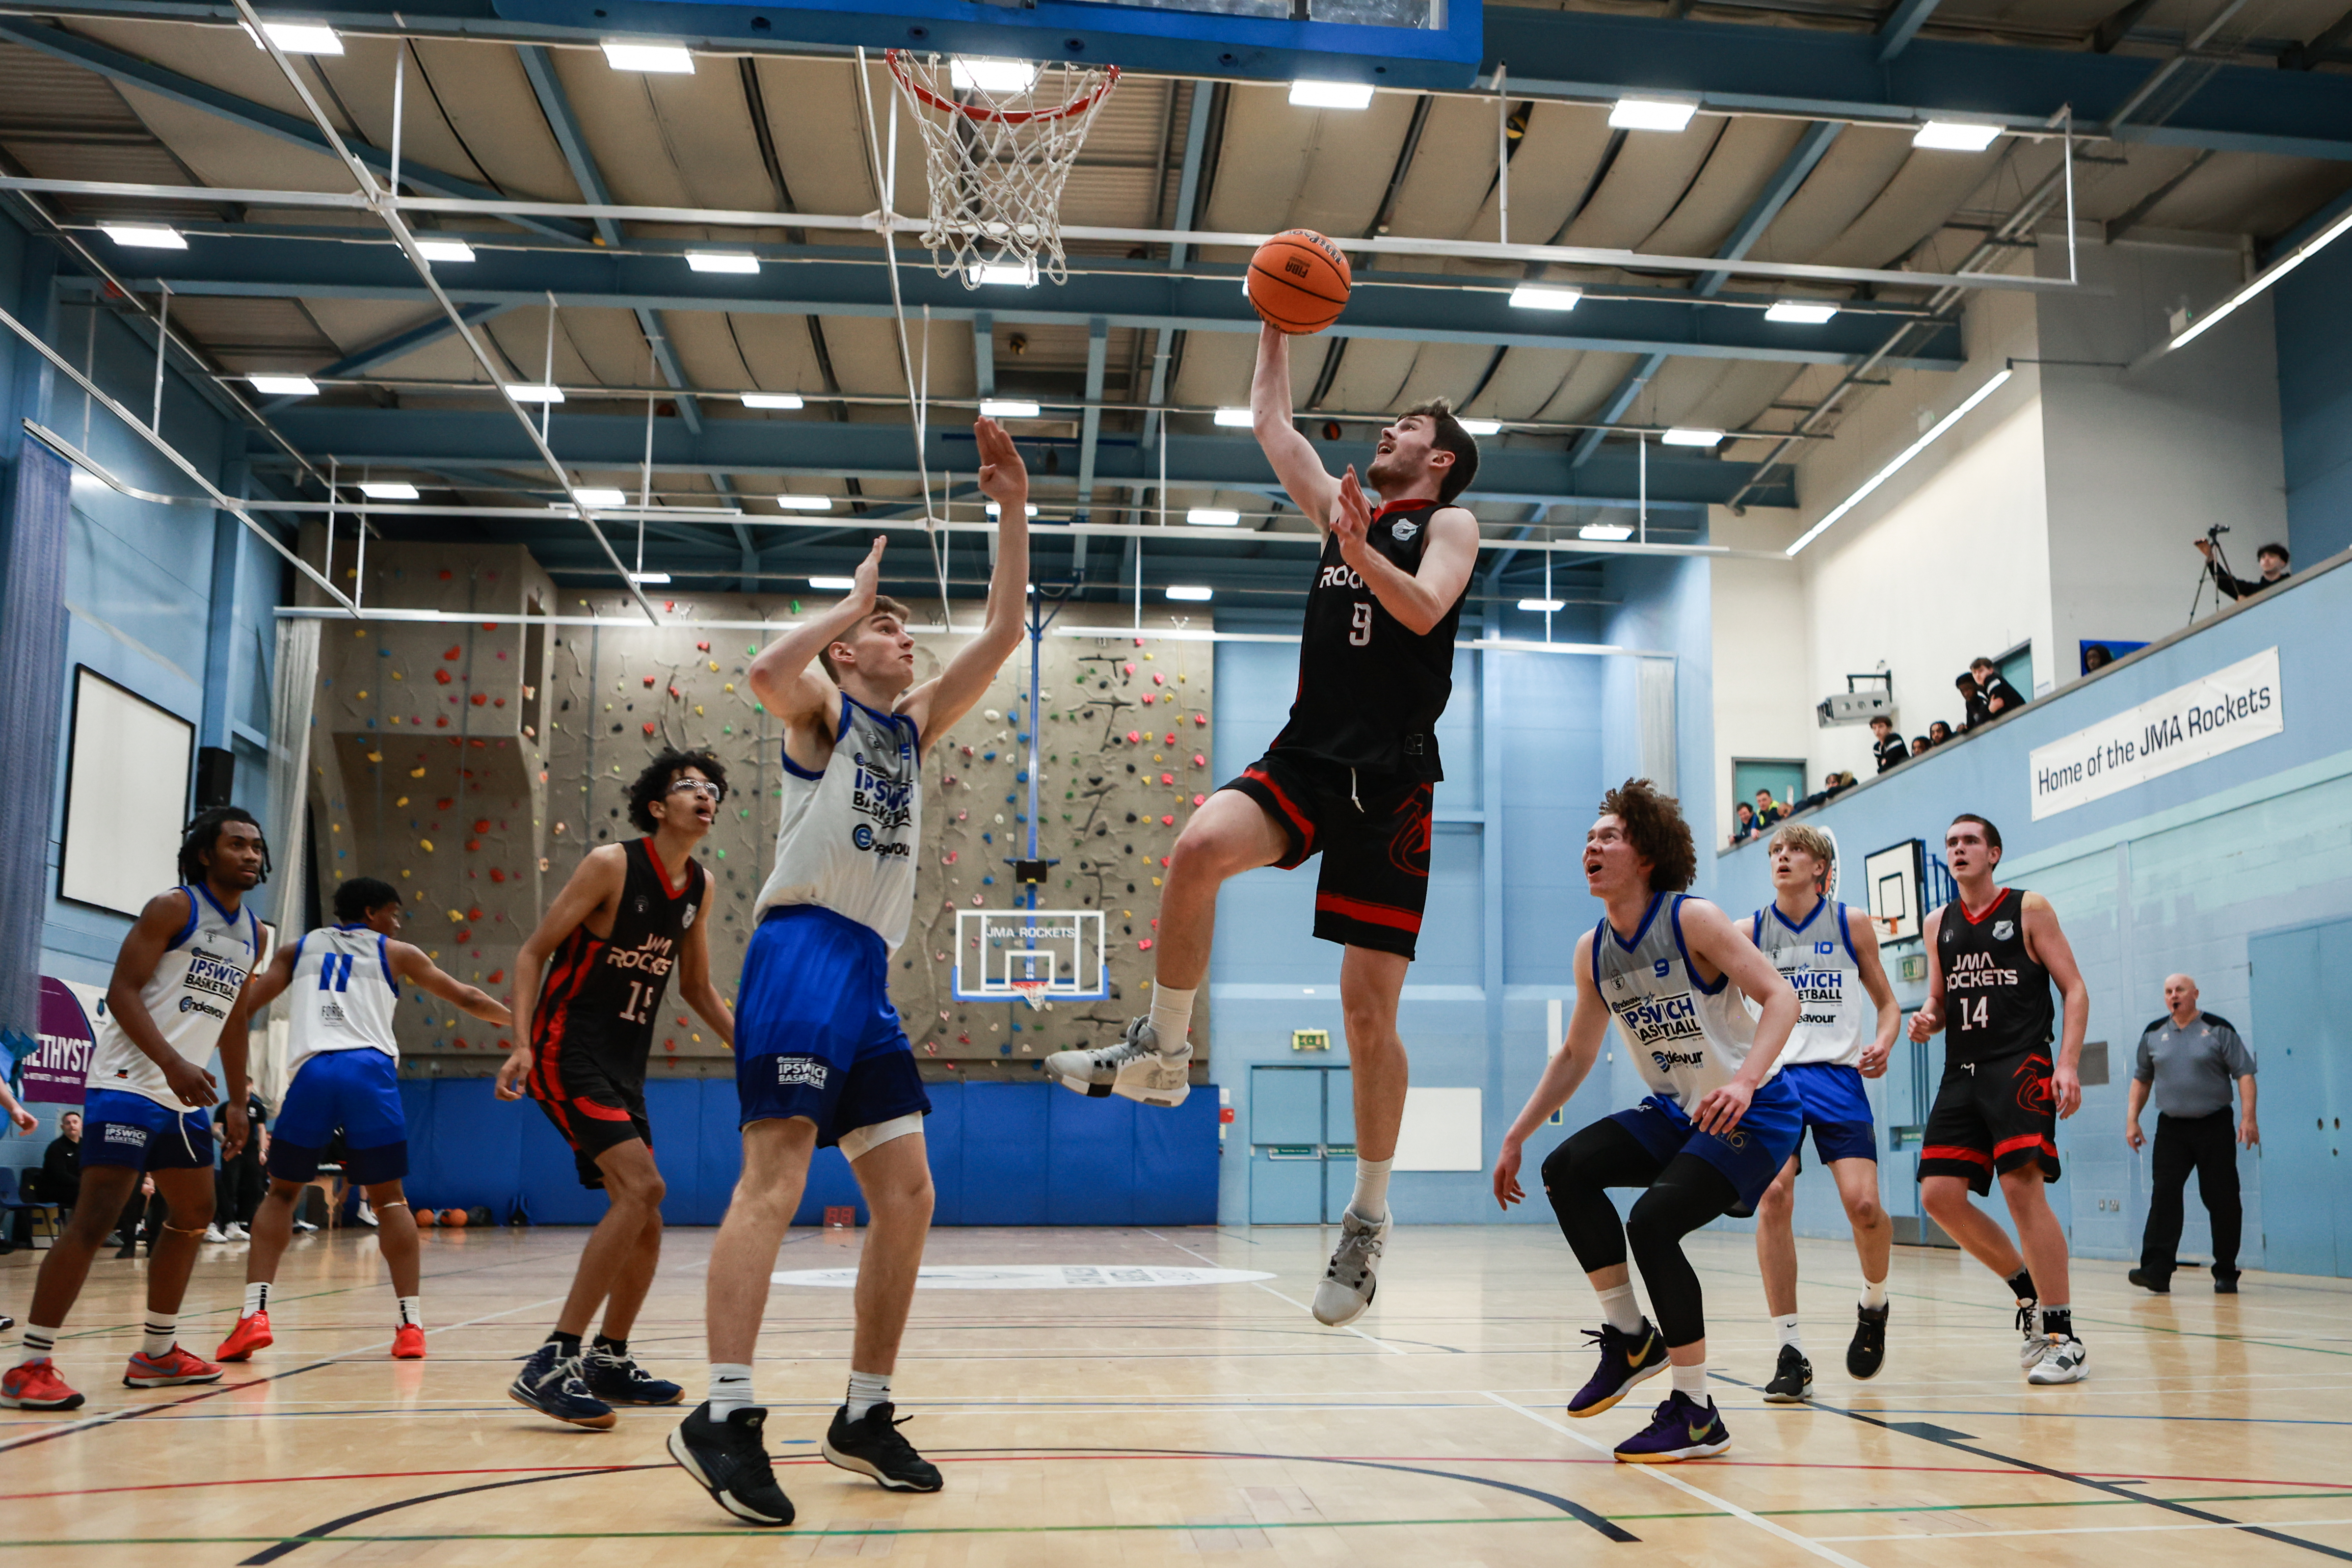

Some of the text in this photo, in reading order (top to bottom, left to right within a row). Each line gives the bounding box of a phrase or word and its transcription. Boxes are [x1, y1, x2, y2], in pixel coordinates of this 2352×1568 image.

[1285, 260, 1309, 278] FIBA
[1349, 602, 1372, 647] 9
[2038, 686, 2271, 796] Home of the JMA Rockets
[986, 927, 1075, 938] JMA ROCKETS
[243, 940, 250, 955] 7
[1815, 941, 1834, 955] 10
[1654, 958, 1670, 978] 9
[1952, 951, 1995, 972] JMA
[319, 952, 355, 993] 11
[1795, 989, 1842, 1000] ETBALL
[1959, 996, 1989, 1031] 14
